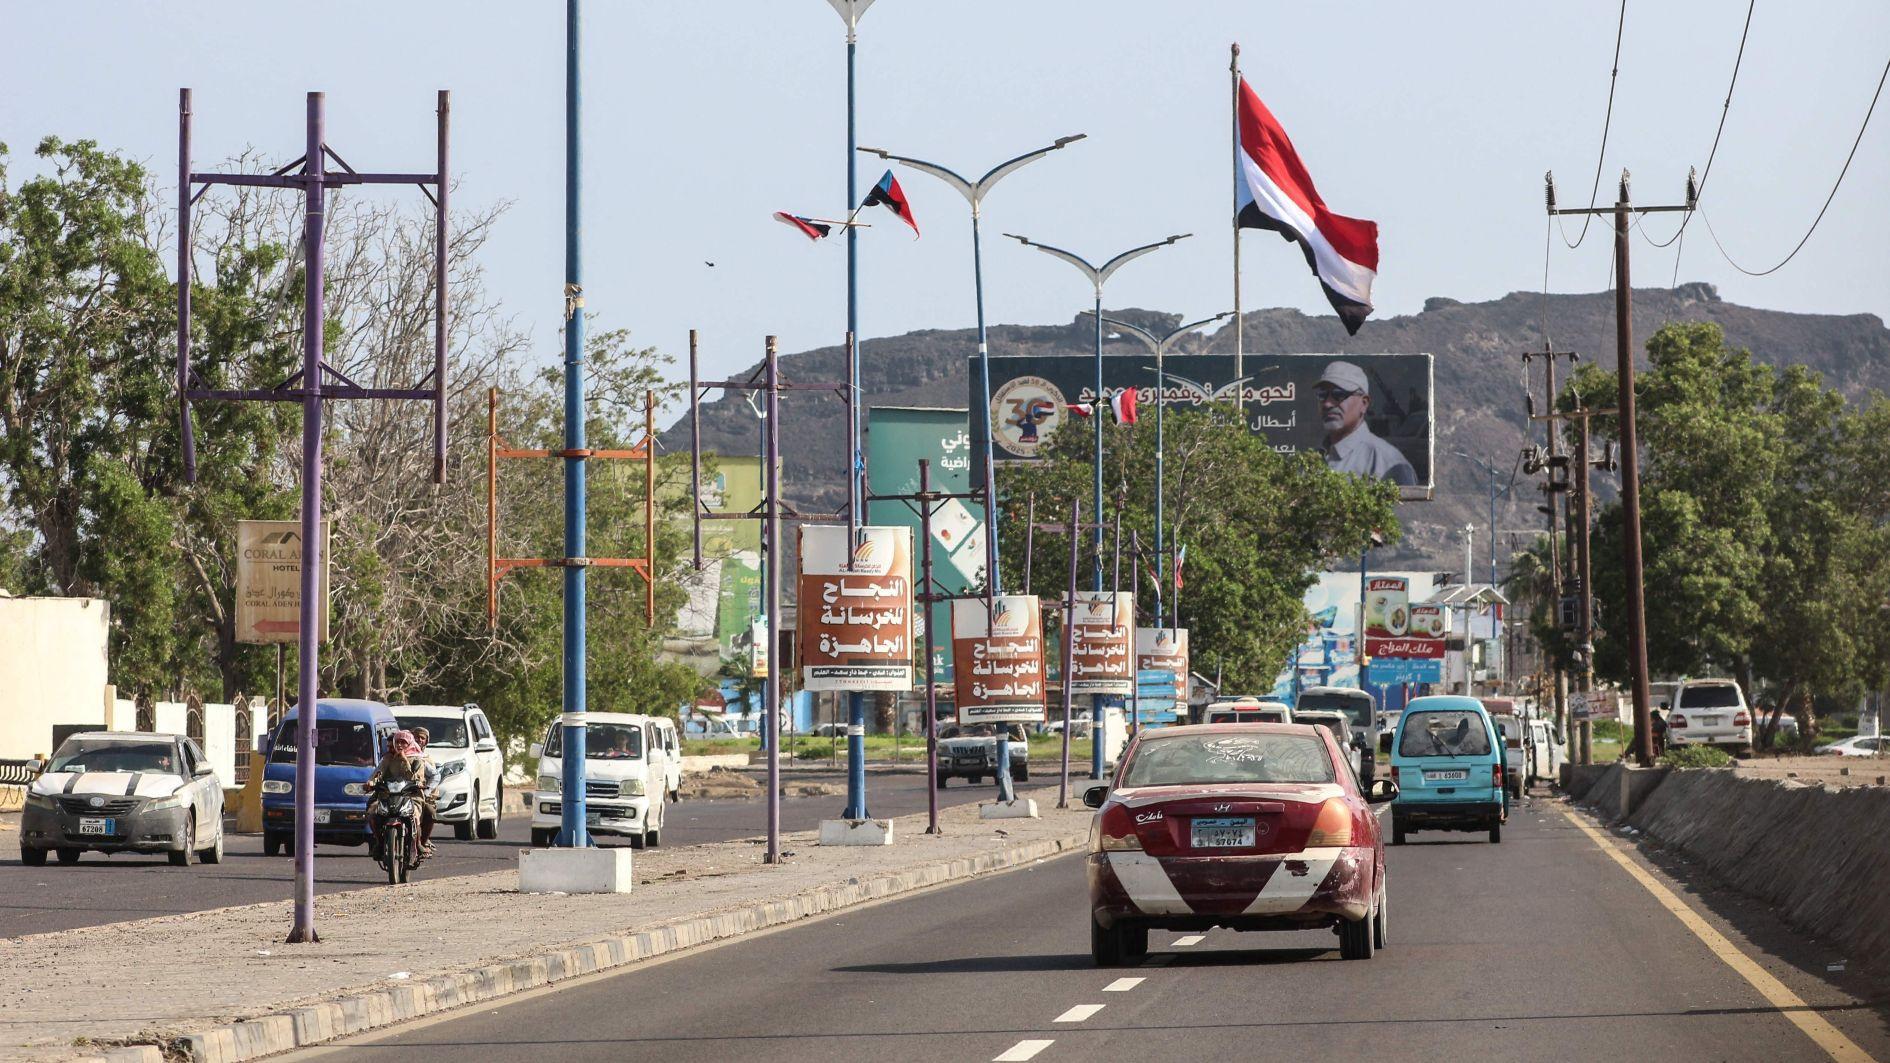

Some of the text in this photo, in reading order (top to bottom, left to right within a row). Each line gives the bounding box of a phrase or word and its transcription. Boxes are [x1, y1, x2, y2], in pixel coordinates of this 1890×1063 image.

[1260, 382, 1295, 405] نحو
[941, 430, 970, 453] وني
[940, 456, 970, 470] راضية
[244, 549, 324, 560] CORAL AN
[823, 578, 903, 604] النجاح
[820, 605, 903, 630] للخرسانة
[820, 633, 903, 658] الجاهزة
[973, 638, 1038, 659] النجاح
[973, 660, 1038, 678] للخرسانة
[1071, 661, 1126, 676] الجاهزة
[973, 681, 1040, 700] الجاهزة
